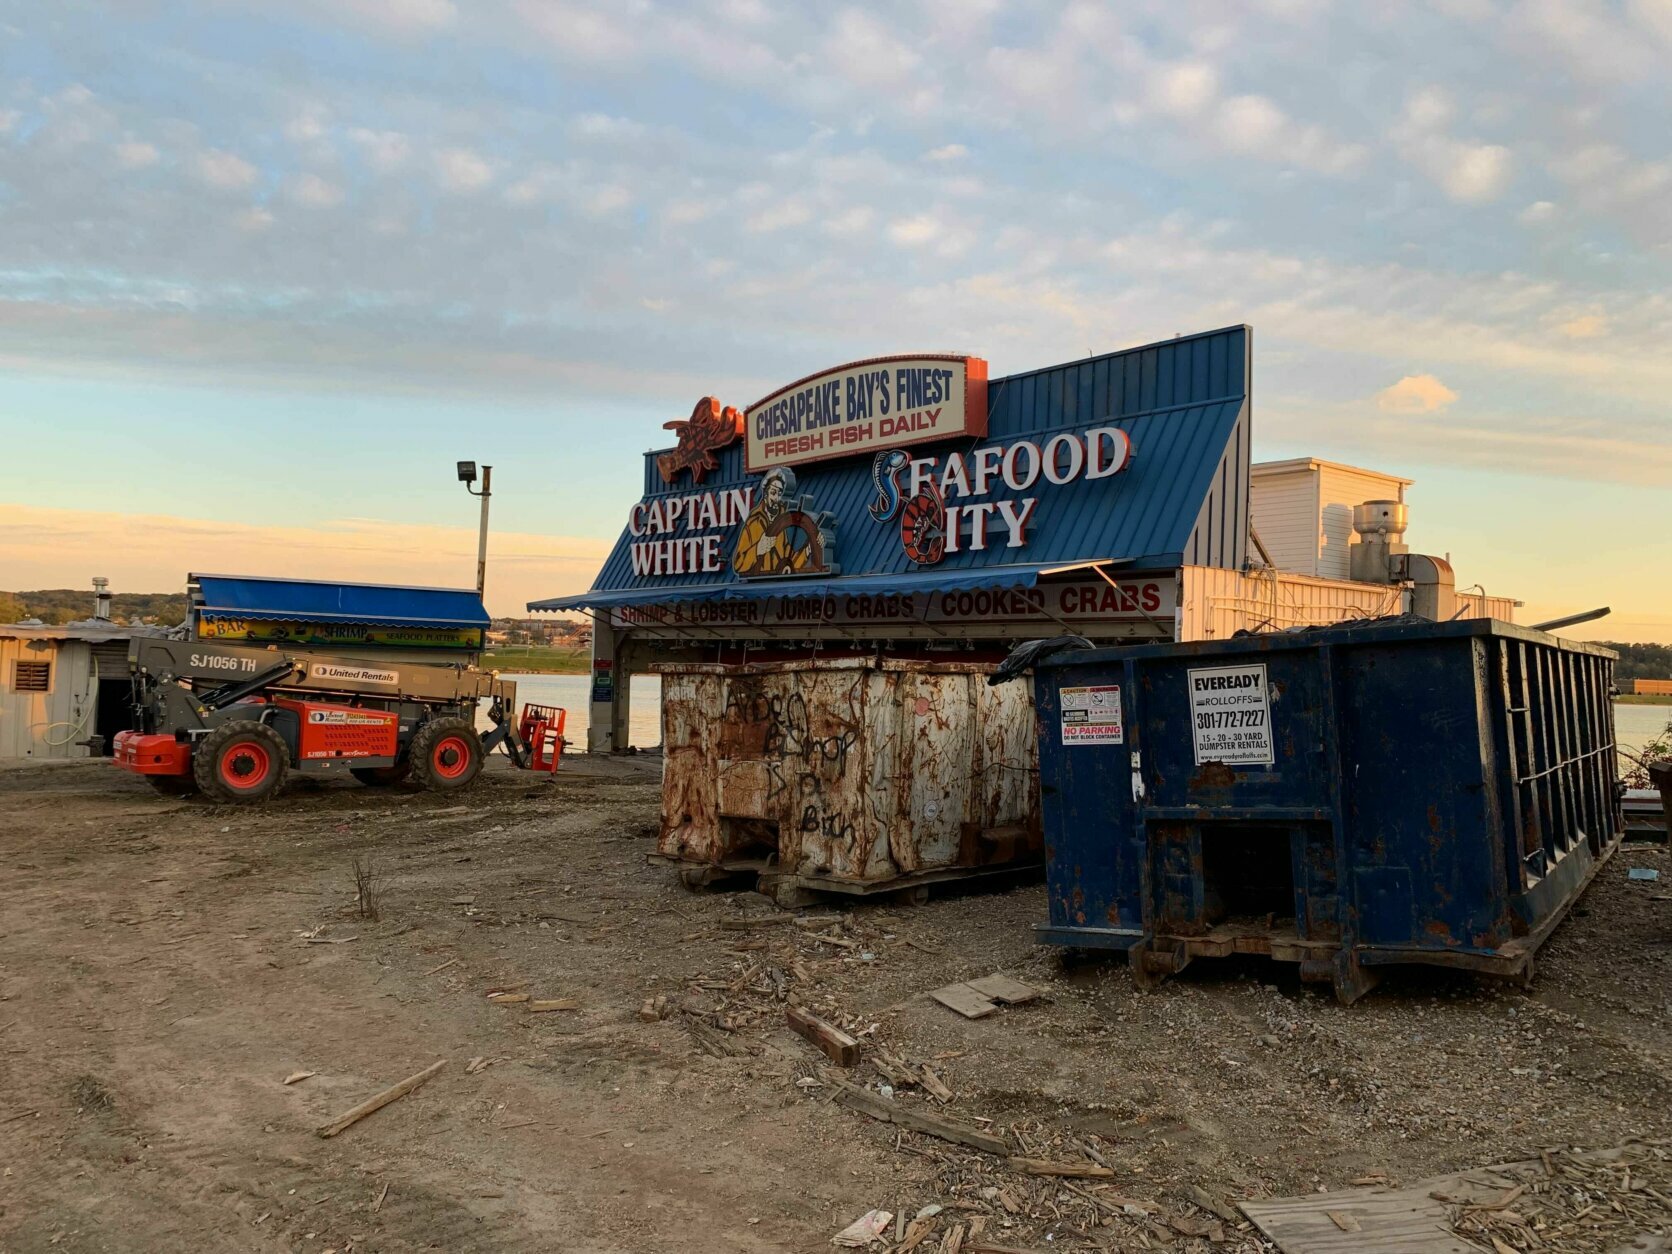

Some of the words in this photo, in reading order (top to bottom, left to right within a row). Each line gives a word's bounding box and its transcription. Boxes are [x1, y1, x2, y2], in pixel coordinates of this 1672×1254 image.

[756, 379, 840, 440] CHESAPEAKE
[846, 369, 890, 422] BAY'S
[896, 368, 953, 412] FINEST
[764, 432, 824, 459] FRESH
[829, 422, 873, 447] FISH
[879, 407, 943, 438] DAILY
[628, 487, 753, 537] CAPTAIN
[630, 535, 721, 576] WHITE
[620, 604, 667, 624] SHRIMP
[690, 600, 758, 622] LOBSTER
[775, 596, 836, 622] JUMBO
[846, 594, 914, 620] CRABS
[941, 588, 1045, 616] COOKED
[1059, 583, 1161, 614] CRABS
[216, 619, 246, 635] BAR
[324, 624, 368, 639] SHRIMP
[386, 632, 423, 641] SEAFOOD
[426, 633, 460, 642] PLATTERS
[190, 653, 238, 670] SJ1056
[241, 658, 257, 672] TH
[328, 668, 360, 679] United
[361, 671, 394, 682] Rentals
[1194, 673, 1260, 691] EVEREADY
[1205, 695, 1253, 706] ROLLOFFS
[1196, 709, 1265, 729] 301-772-7227
[1063, 727, 1077, 735] NO
[1079, 726, 1121, 735] PARKING
[1202, 734, 1211, 742] 15
[1217, 733, 1226, 741] 20
[1233, 733, 1242, 741] 30
[1243, 732, 1263, 740] YARD
[1199, 741, 1236, 751] DUMPSTER
[1237, 740, 1268, 749] RENTALS
